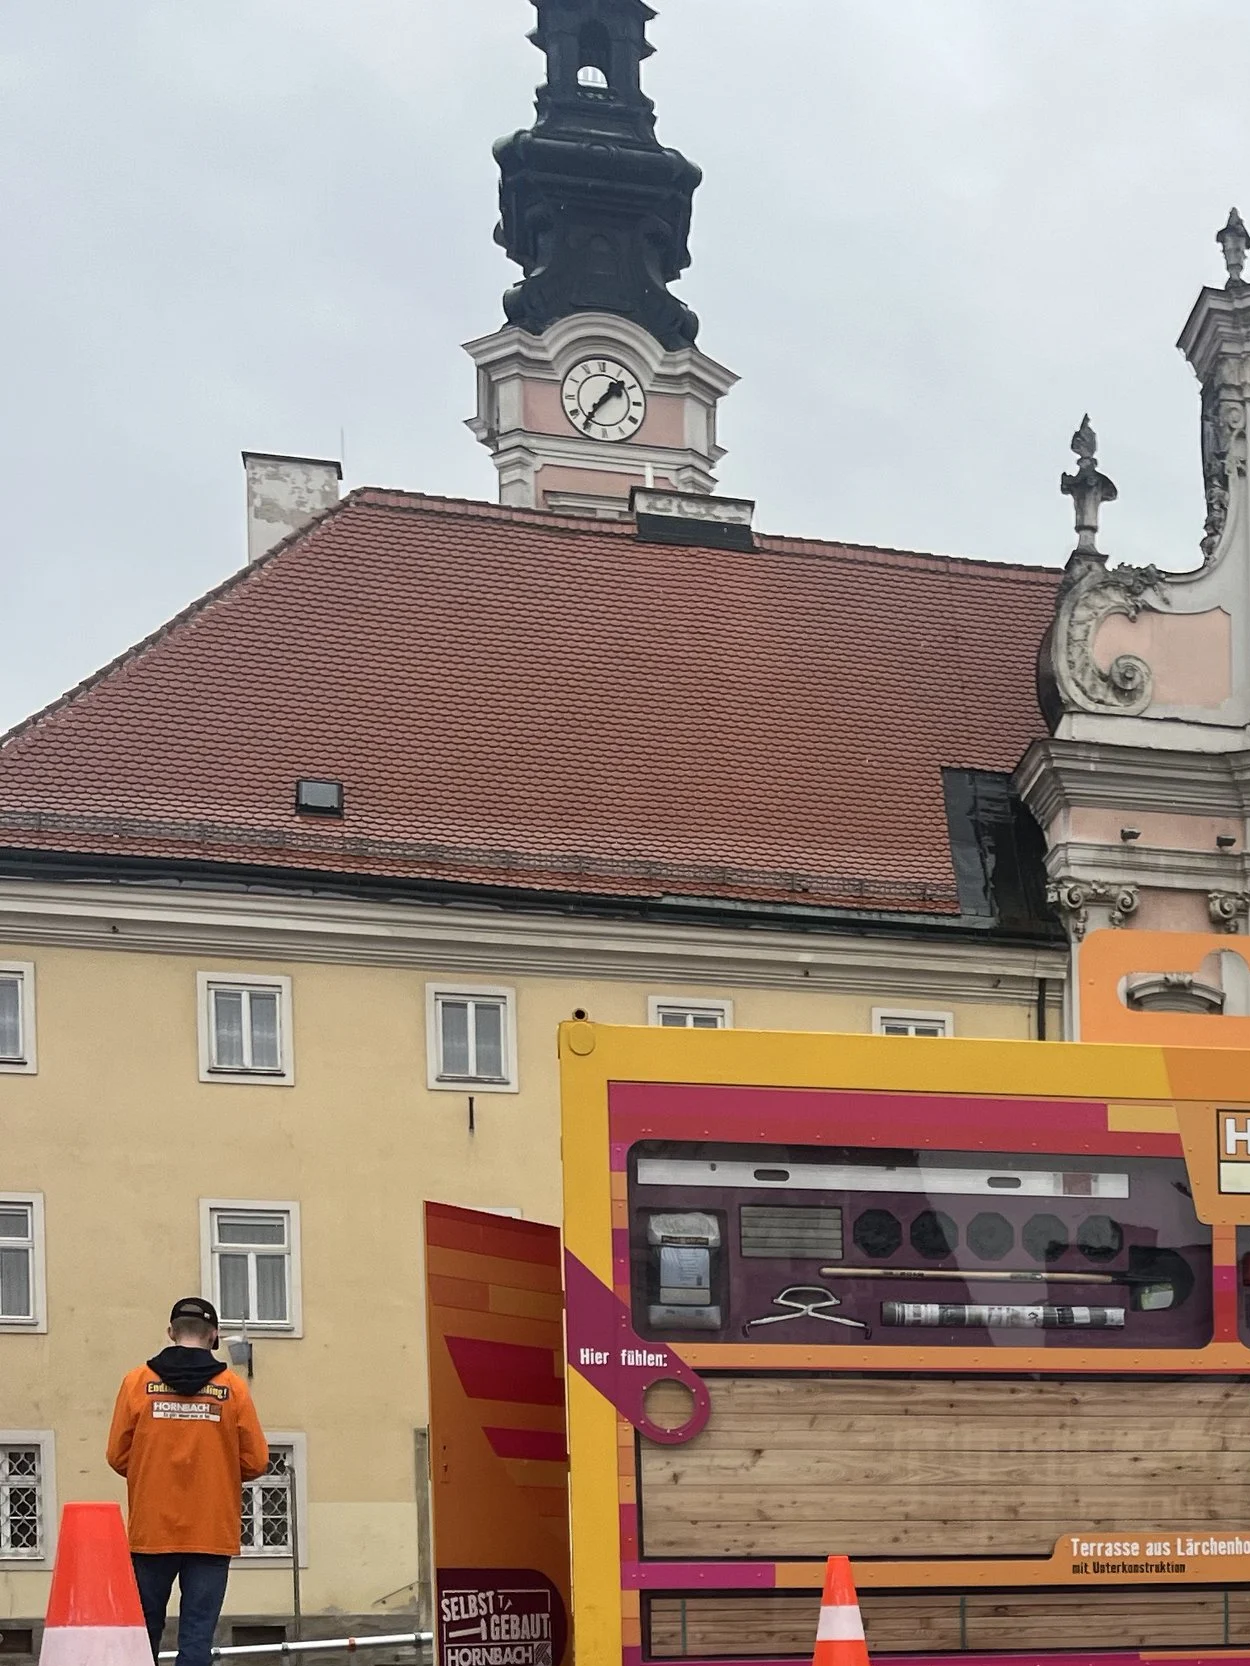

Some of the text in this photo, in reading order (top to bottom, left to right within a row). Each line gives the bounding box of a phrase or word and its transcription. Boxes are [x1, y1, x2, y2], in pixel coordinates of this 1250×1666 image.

[580, 1348, 668, 1367] Hier fühlen:
[153, 1401, 210, 1413] HORNBACH
[1070, 1537, 1140, 1557] Terrasse
[1146, 1544, 1171, 1556] aus
[1072, 1561, 1186, 1575] mit Unterkonstruktion
[441, 1591, 494, 1622] SELBST
[490, 1613, 550, 1641] GEBAUT
